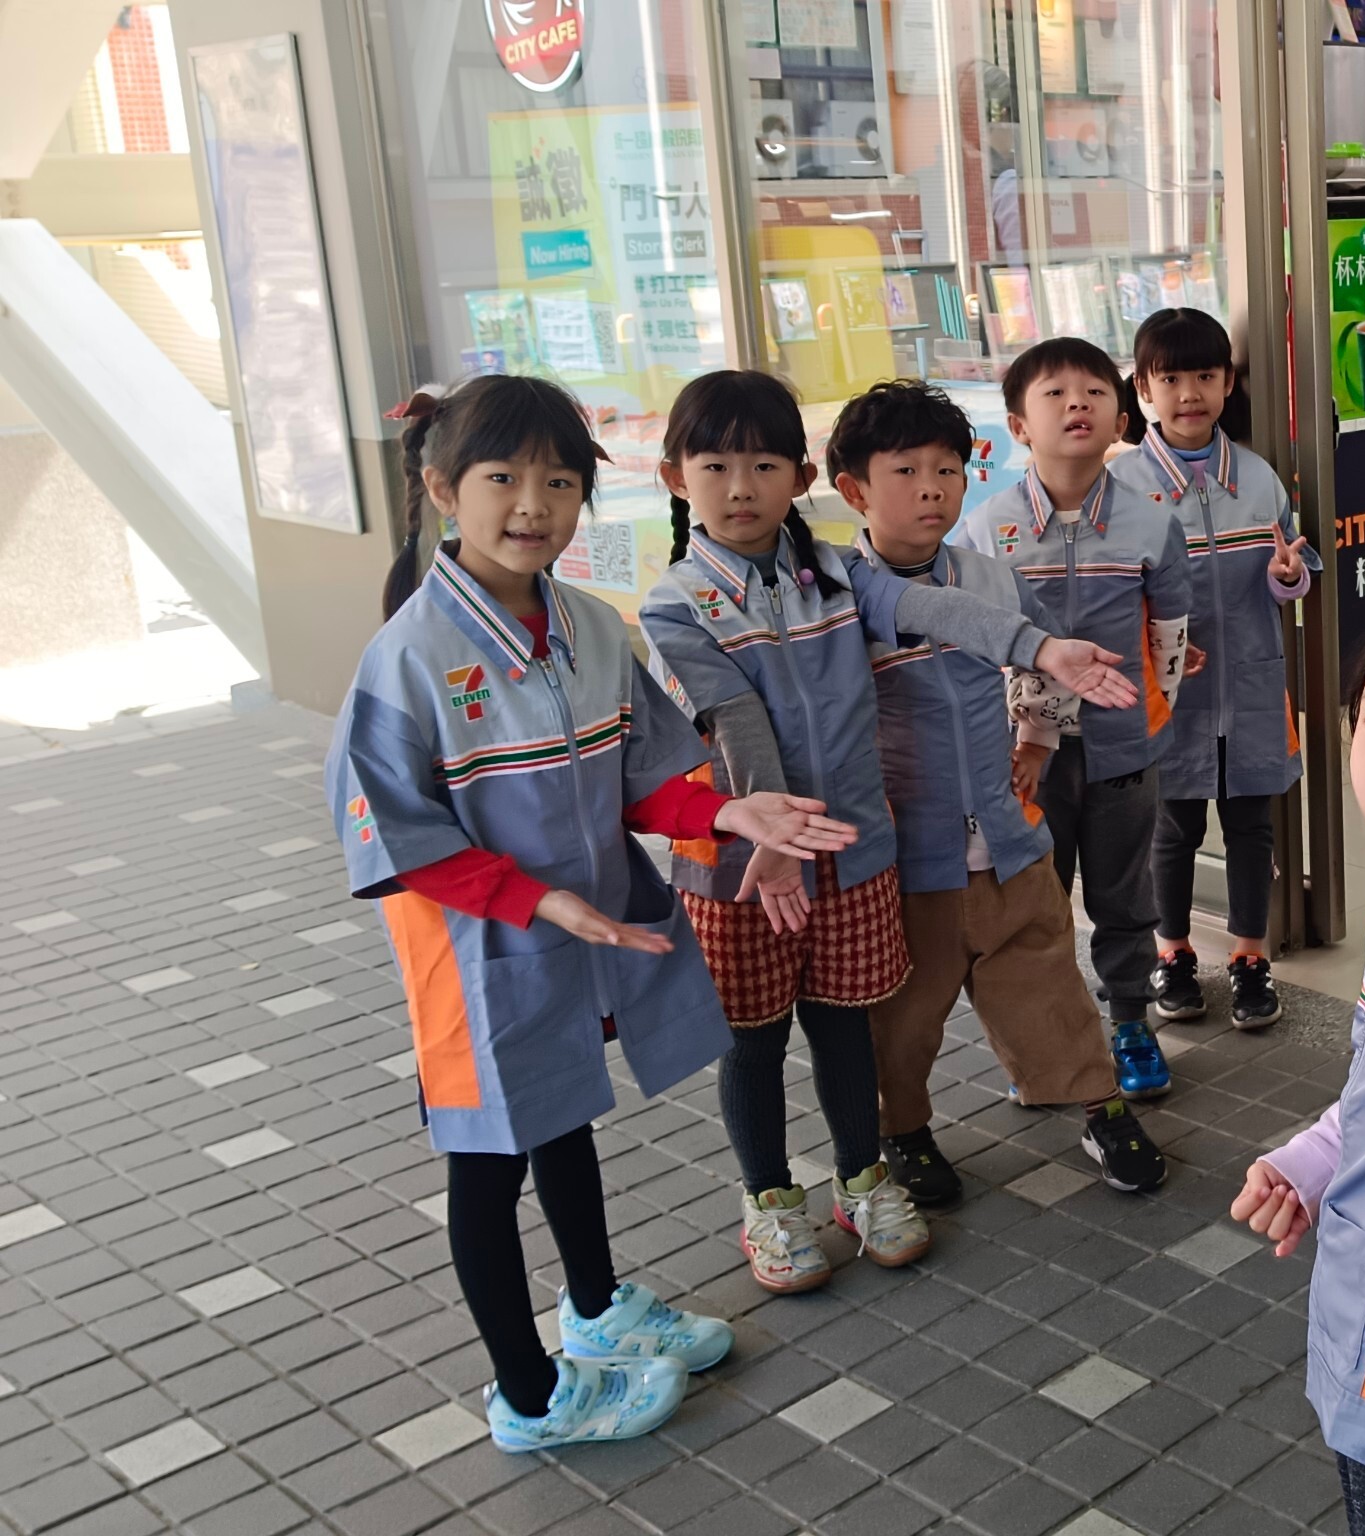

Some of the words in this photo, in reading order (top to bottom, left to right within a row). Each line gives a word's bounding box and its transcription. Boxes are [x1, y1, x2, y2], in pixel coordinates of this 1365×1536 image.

[505, 35, 537, 64] CITY
[538, 18, 578, 52] CAFE
[530, 246, 557, 265] Now
[558, 243, 590, 262] Hiring
[673, 234, 704, 254] Clerk
